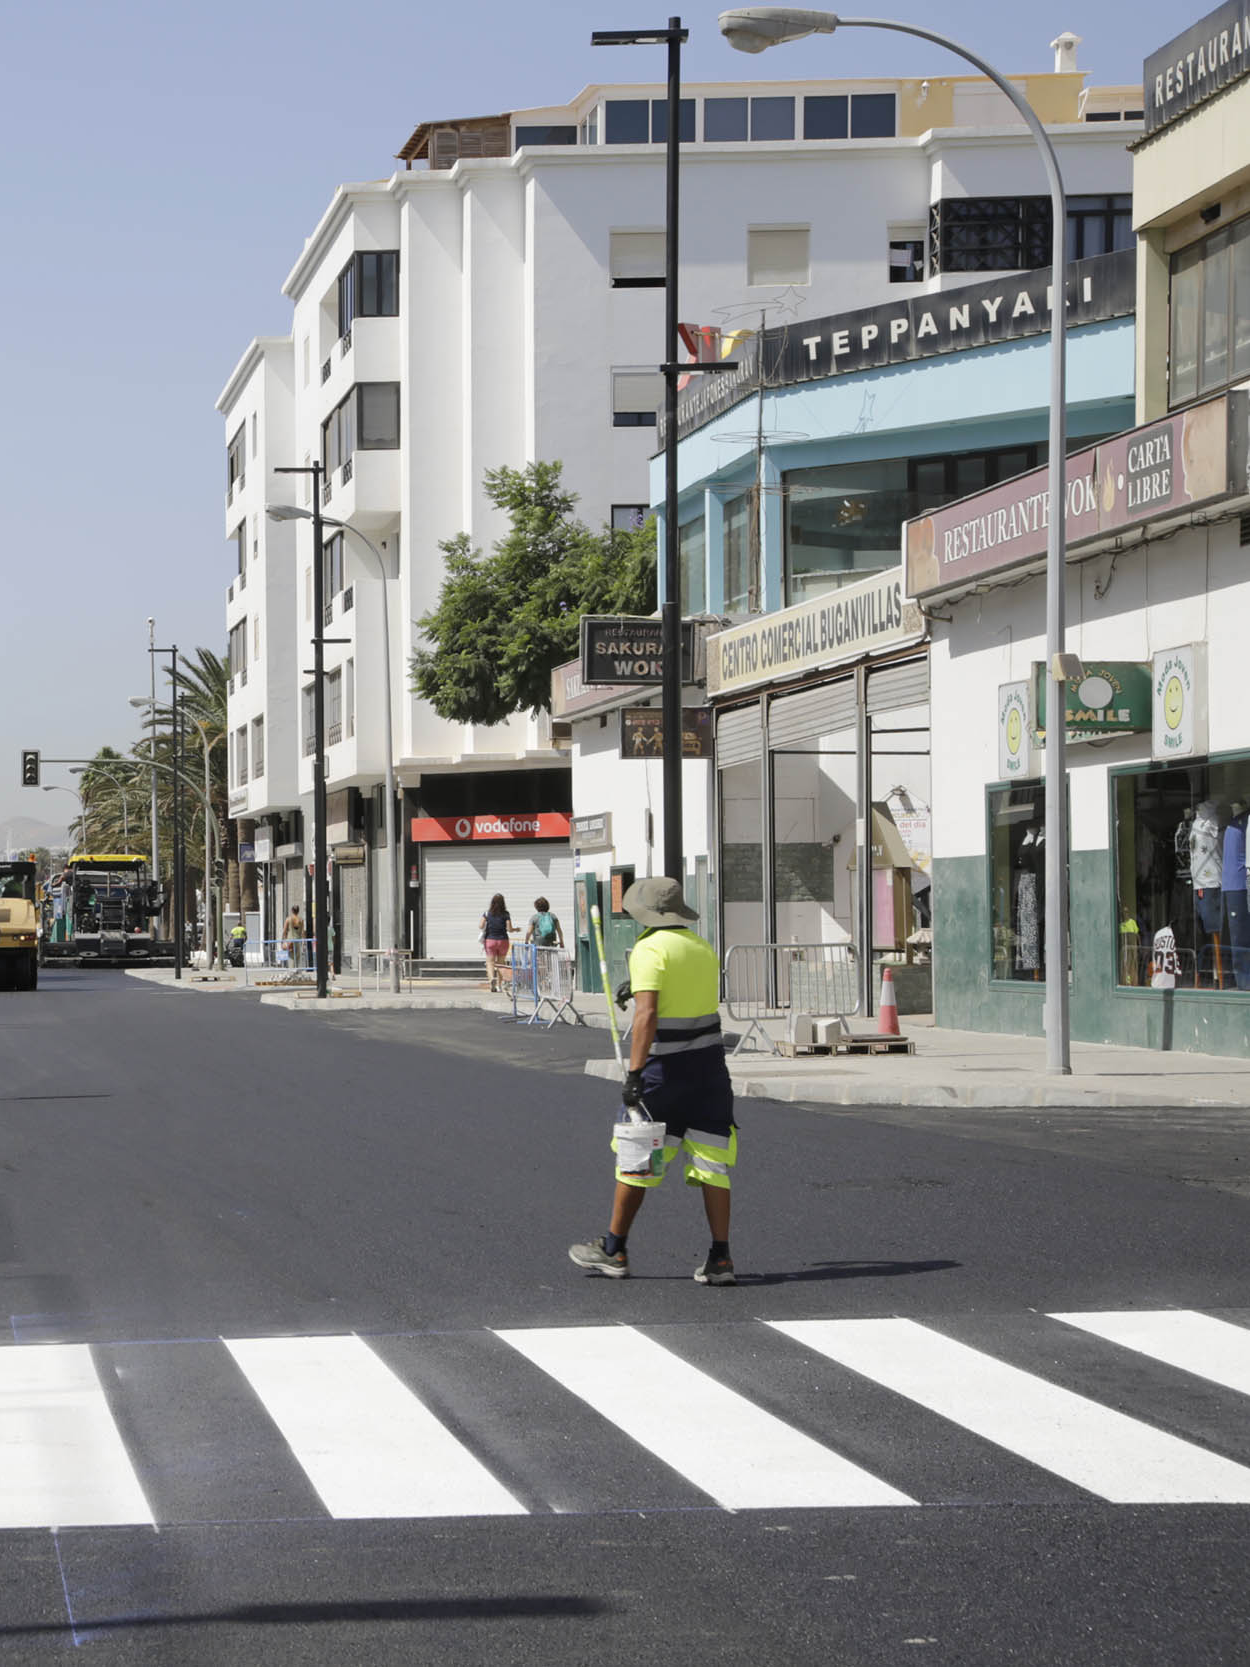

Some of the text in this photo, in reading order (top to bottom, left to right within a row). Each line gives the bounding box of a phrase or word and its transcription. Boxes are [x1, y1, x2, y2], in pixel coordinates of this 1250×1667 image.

[1128, 434, 1170, 473] CARTA
[1128, 468, 1170, 508] LIBRE
[722, 582, 902, 681] CENTRO COMERCIAL BUGANVILLAS
[1065, 708, 1130, 723] SMILE
[1163, 732, 1183, 749] SMILE
[475, 817, 541, 833] vodafone
